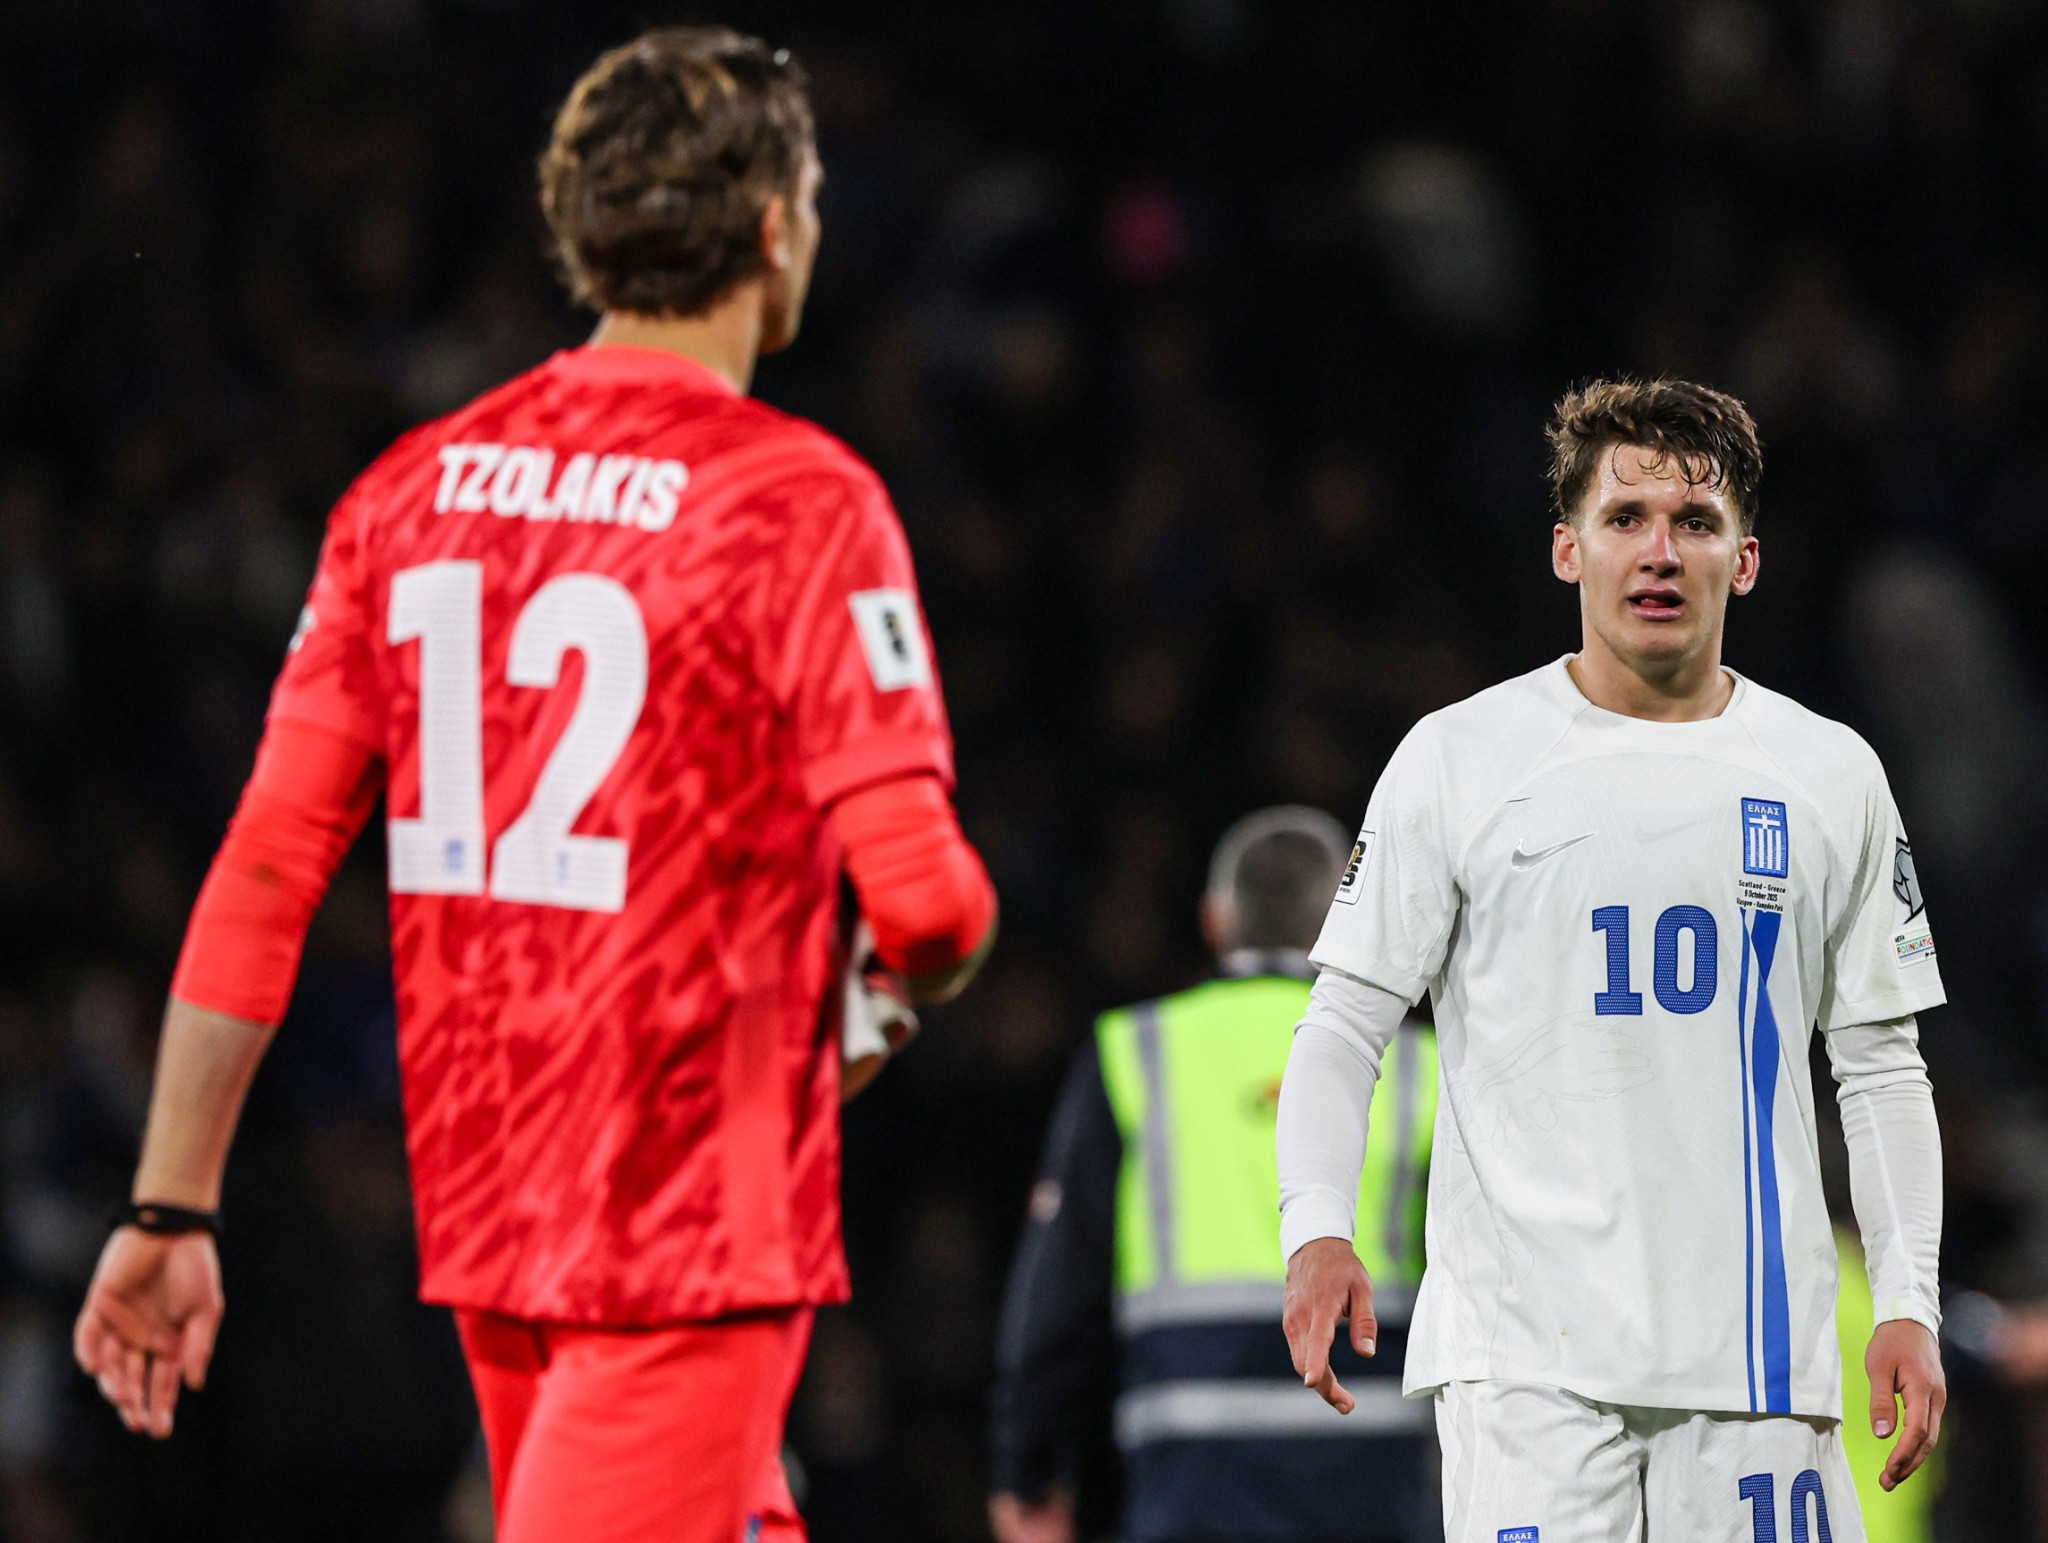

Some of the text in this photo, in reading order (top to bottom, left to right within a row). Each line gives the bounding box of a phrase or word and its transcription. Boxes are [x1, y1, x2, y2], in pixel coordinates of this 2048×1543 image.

[434, 443, 689, 533] TZOLAKIS
[387, 558, 650, 913] 12
[1738, 879, 1763, 890] Scotland
[1768, 884, 1786, 894] Greece
[1748, 889, 1767, 900] October
[1767, 893, 1778, 902] 2025
[1774, 904, 1784, 912] Park
[1592, 904, 1719, 1017] 10
[1738, 1468, 1834, 1543] 10
